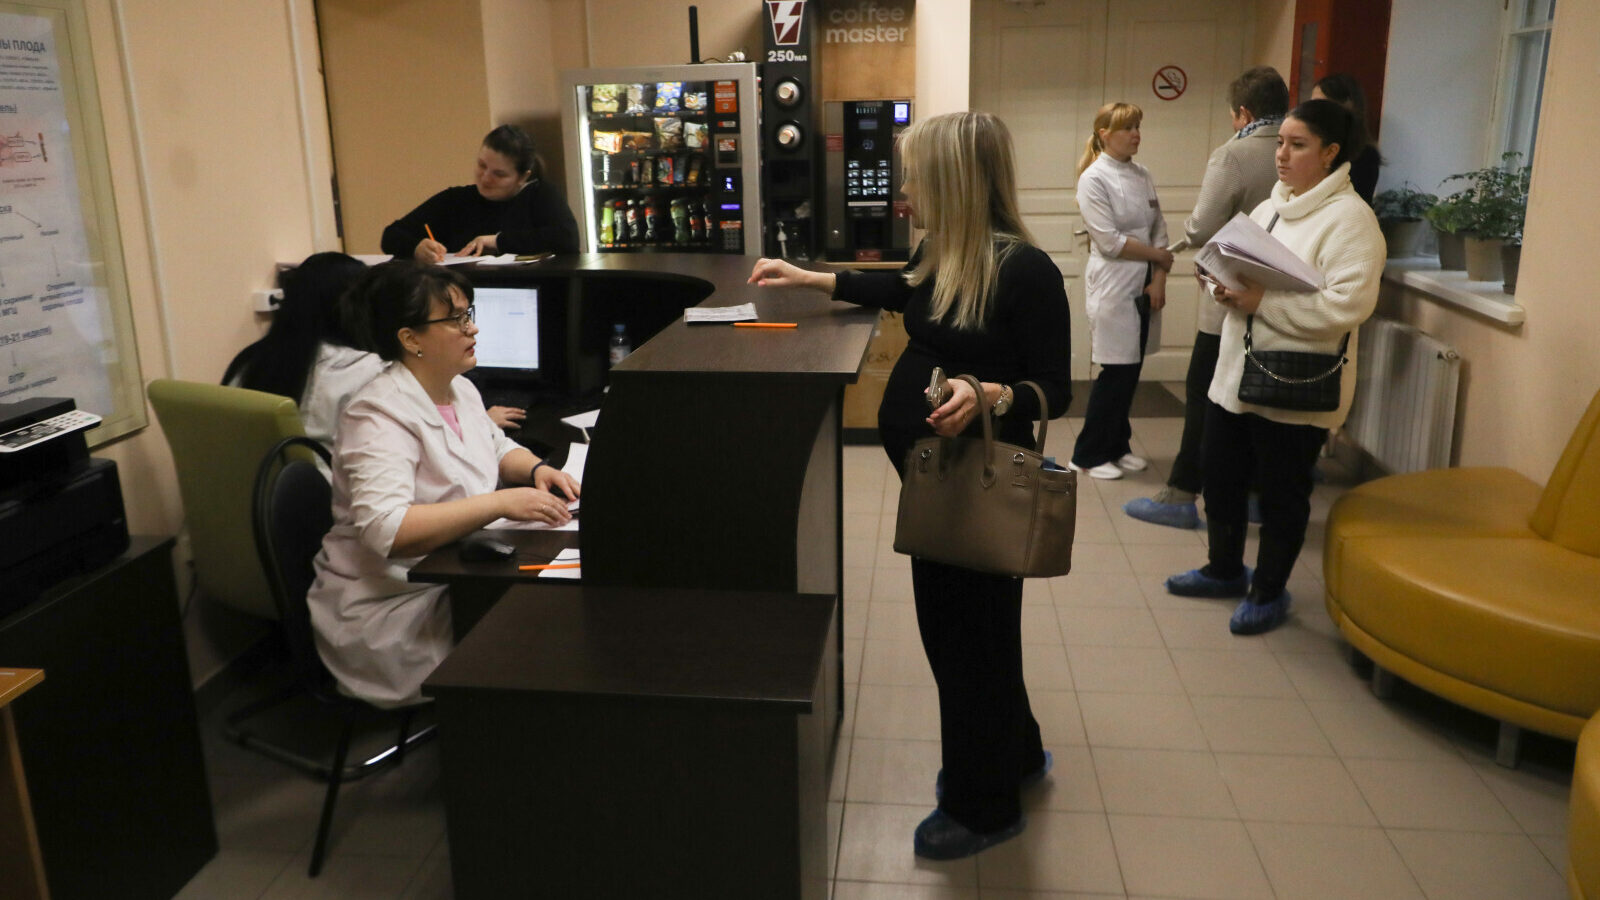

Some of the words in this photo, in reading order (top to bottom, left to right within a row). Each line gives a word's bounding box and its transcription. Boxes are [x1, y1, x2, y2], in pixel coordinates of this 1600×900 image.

[829, 2, 905, 23] coffee
[826, 25, 909, 45] master
[13, 40, 46, 53] ПЛОДА
